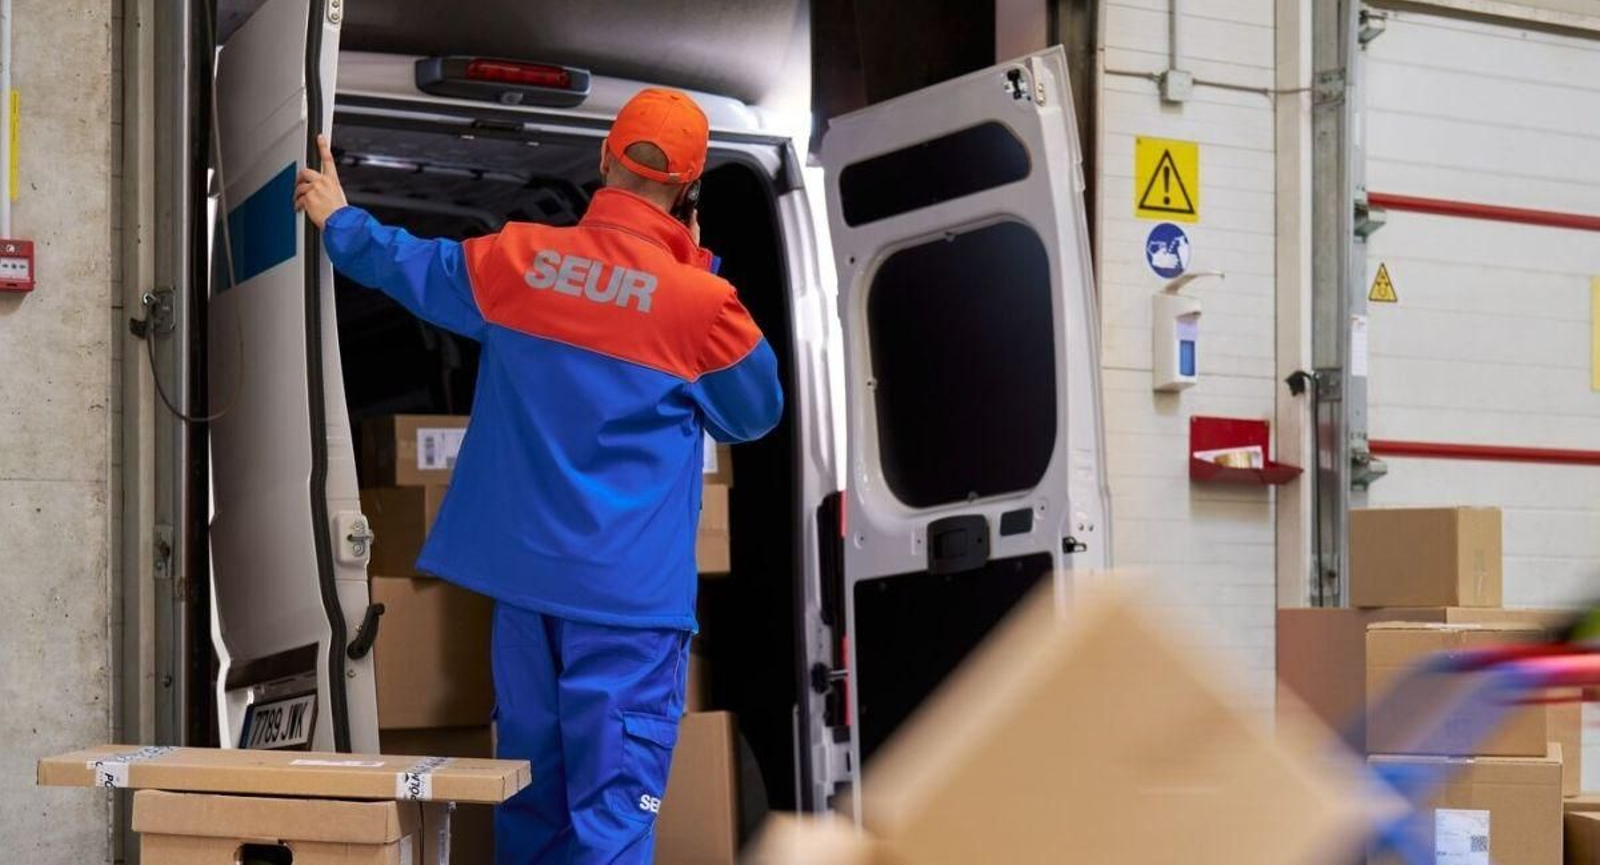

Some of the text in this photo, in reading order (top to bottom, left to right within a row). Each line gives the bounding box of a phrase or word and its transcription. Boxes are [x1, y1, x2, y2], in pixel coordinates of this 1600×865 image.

[524, 249, 658, 313] SEUR
[250, 702, 308, 746] 7789 JWK
